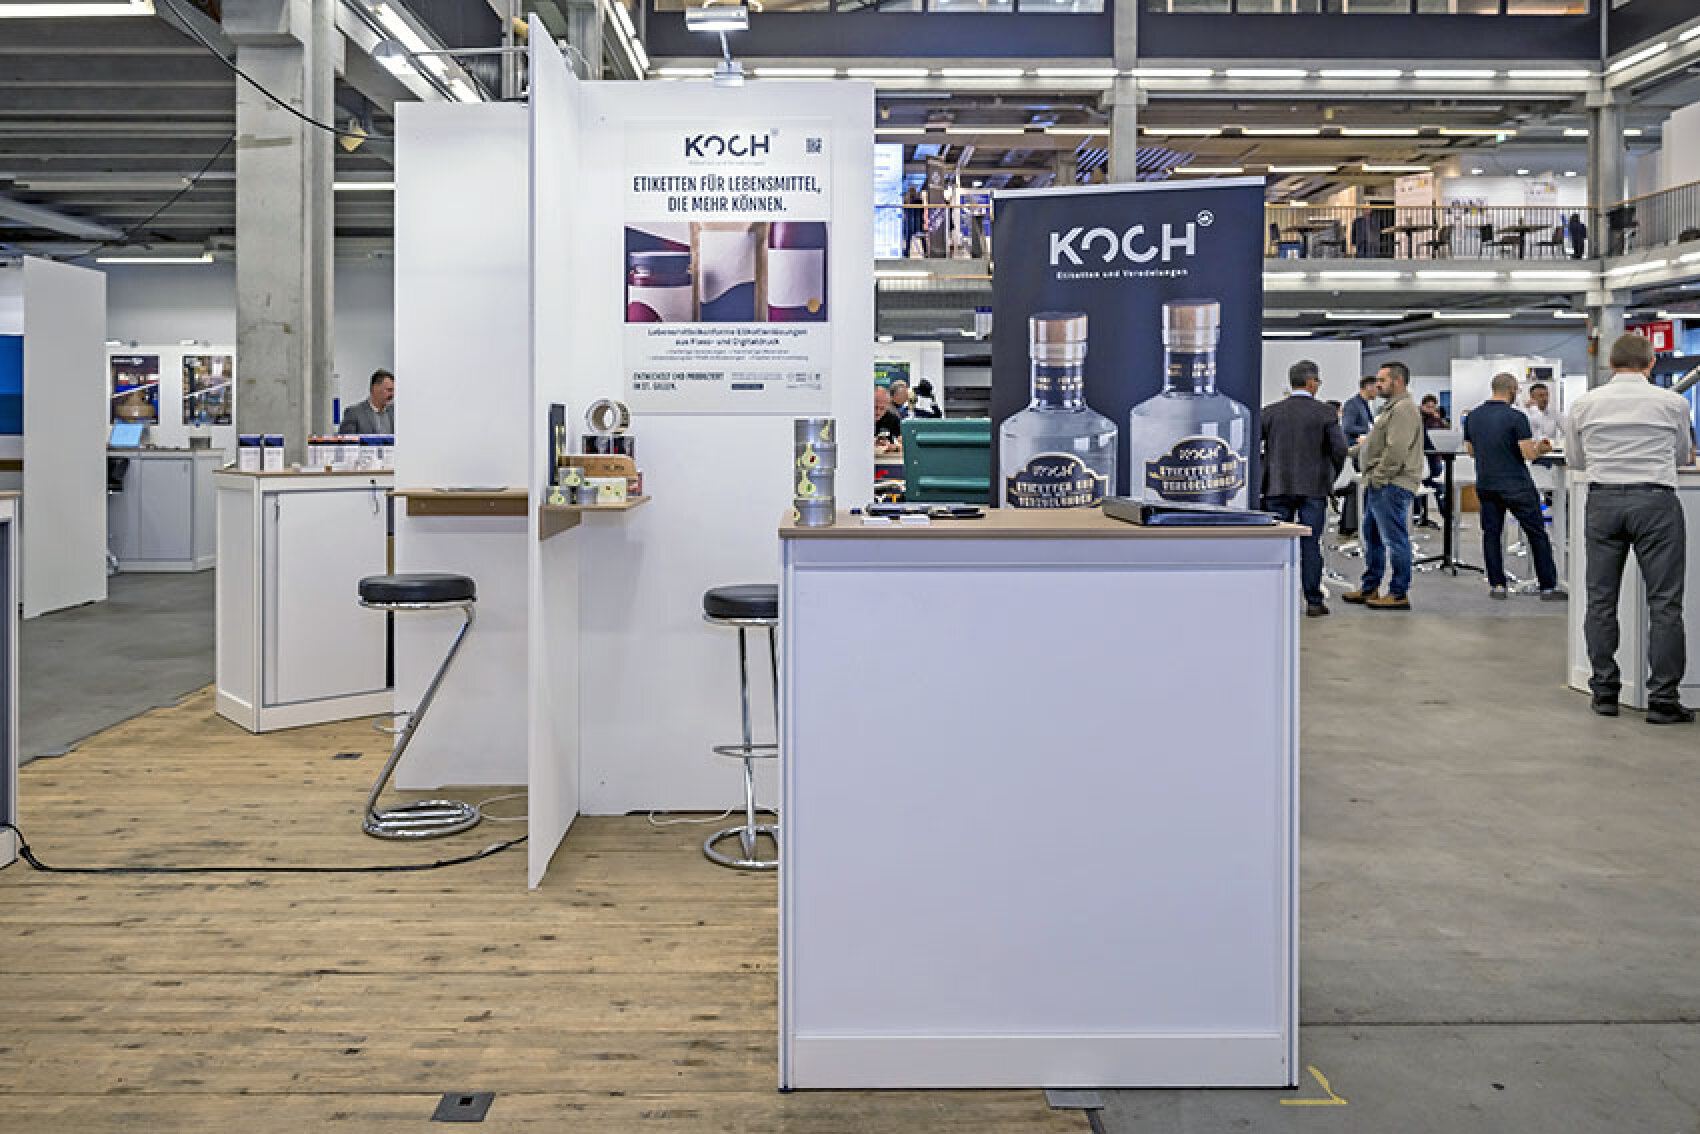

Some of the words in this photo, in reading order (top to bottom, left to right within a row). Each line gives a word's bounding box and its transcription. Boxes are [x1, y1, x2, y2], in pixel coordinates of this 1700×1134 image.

[685, 134, 769, 157] KOCH
[633, 175, 697, 192] ETIKETTEN
[701, 173, 725, 192] FÜR
[729, 175, 822, 194] LEBENSMITTEL,
[668, 195, 689, 212] DIE
[692, 195, 728, 212] MEHR
[732, 194, 787, 212] KÖNNEN.
[1050, 222, 1196, 265] KOCH
